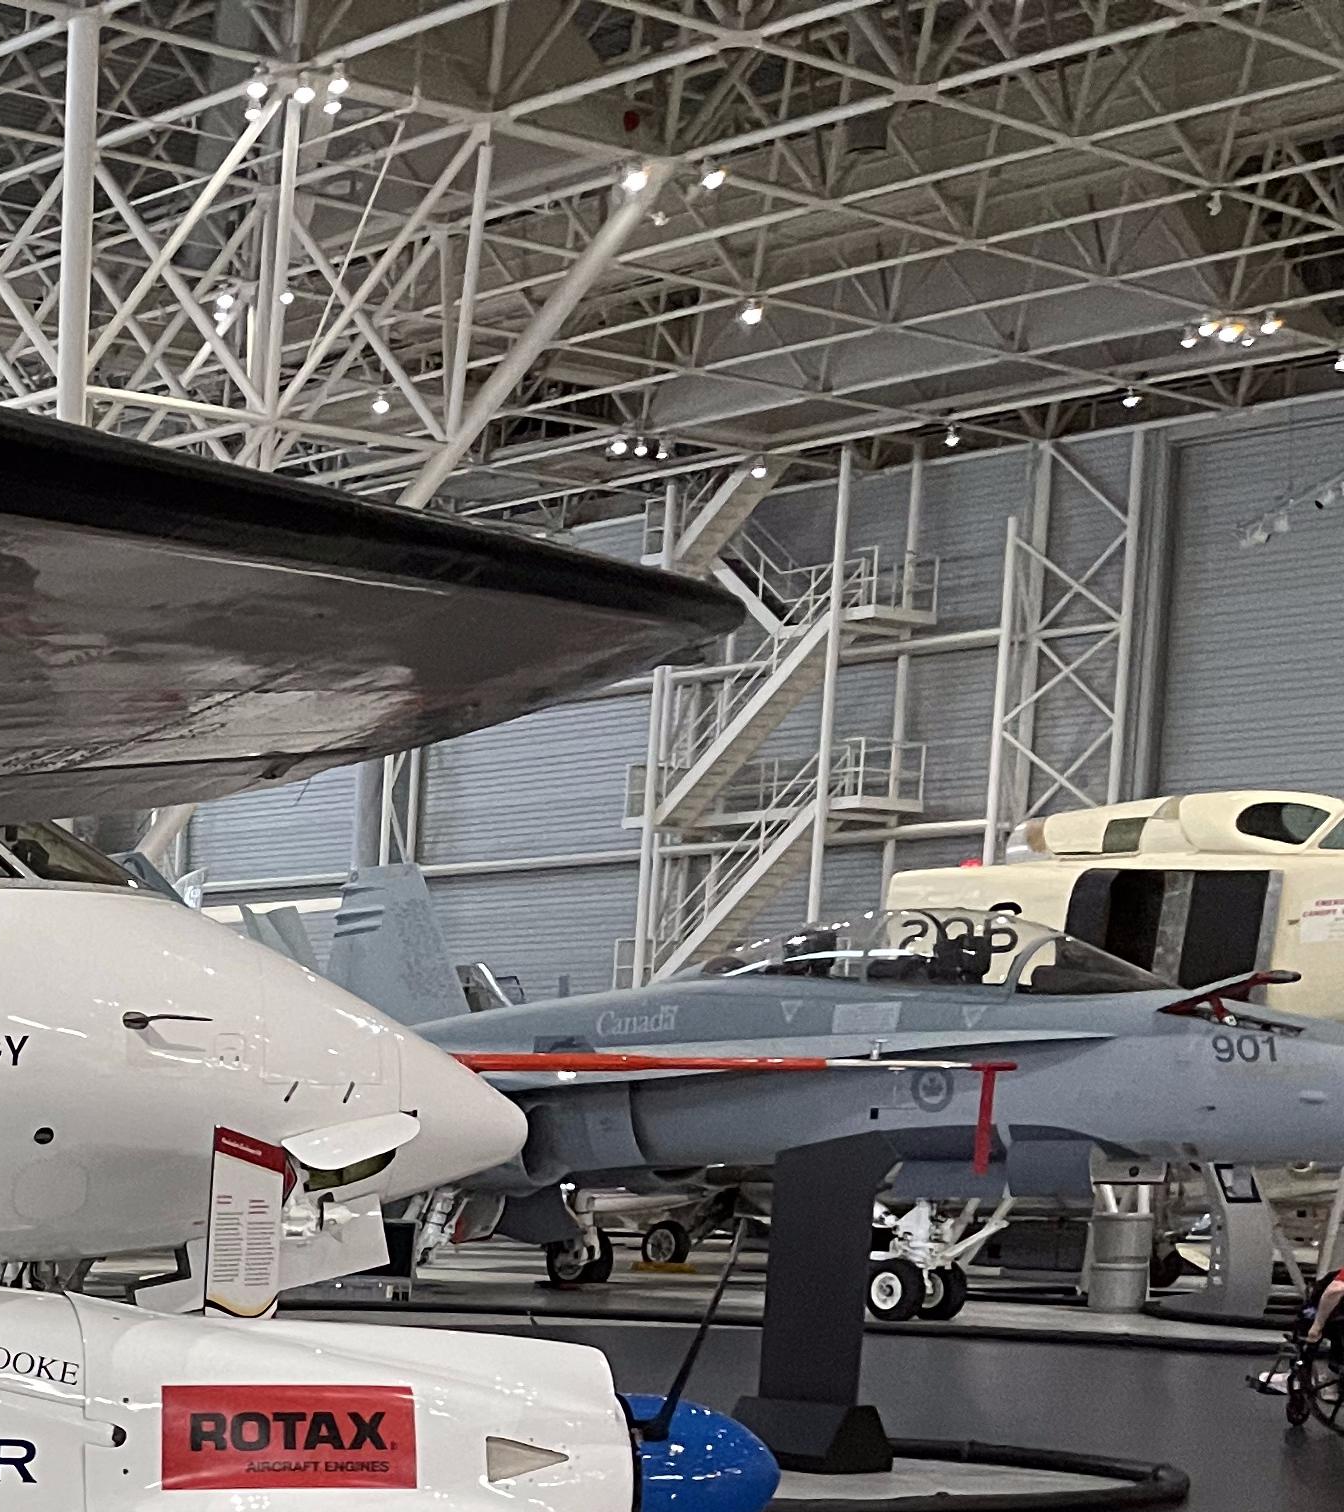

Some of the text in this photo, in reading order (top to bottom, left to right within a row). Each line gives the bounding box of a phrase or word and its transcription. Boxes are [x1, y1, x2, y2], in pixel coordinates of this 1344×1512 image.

[596, 1005, 678, 1037] Canada
[1212, 1035, 1277, 1062] 901
[190, 1412, 388, 1451] ROTAX
[246, 1461, 390, 1472] AIRCRAFT ENGINES
